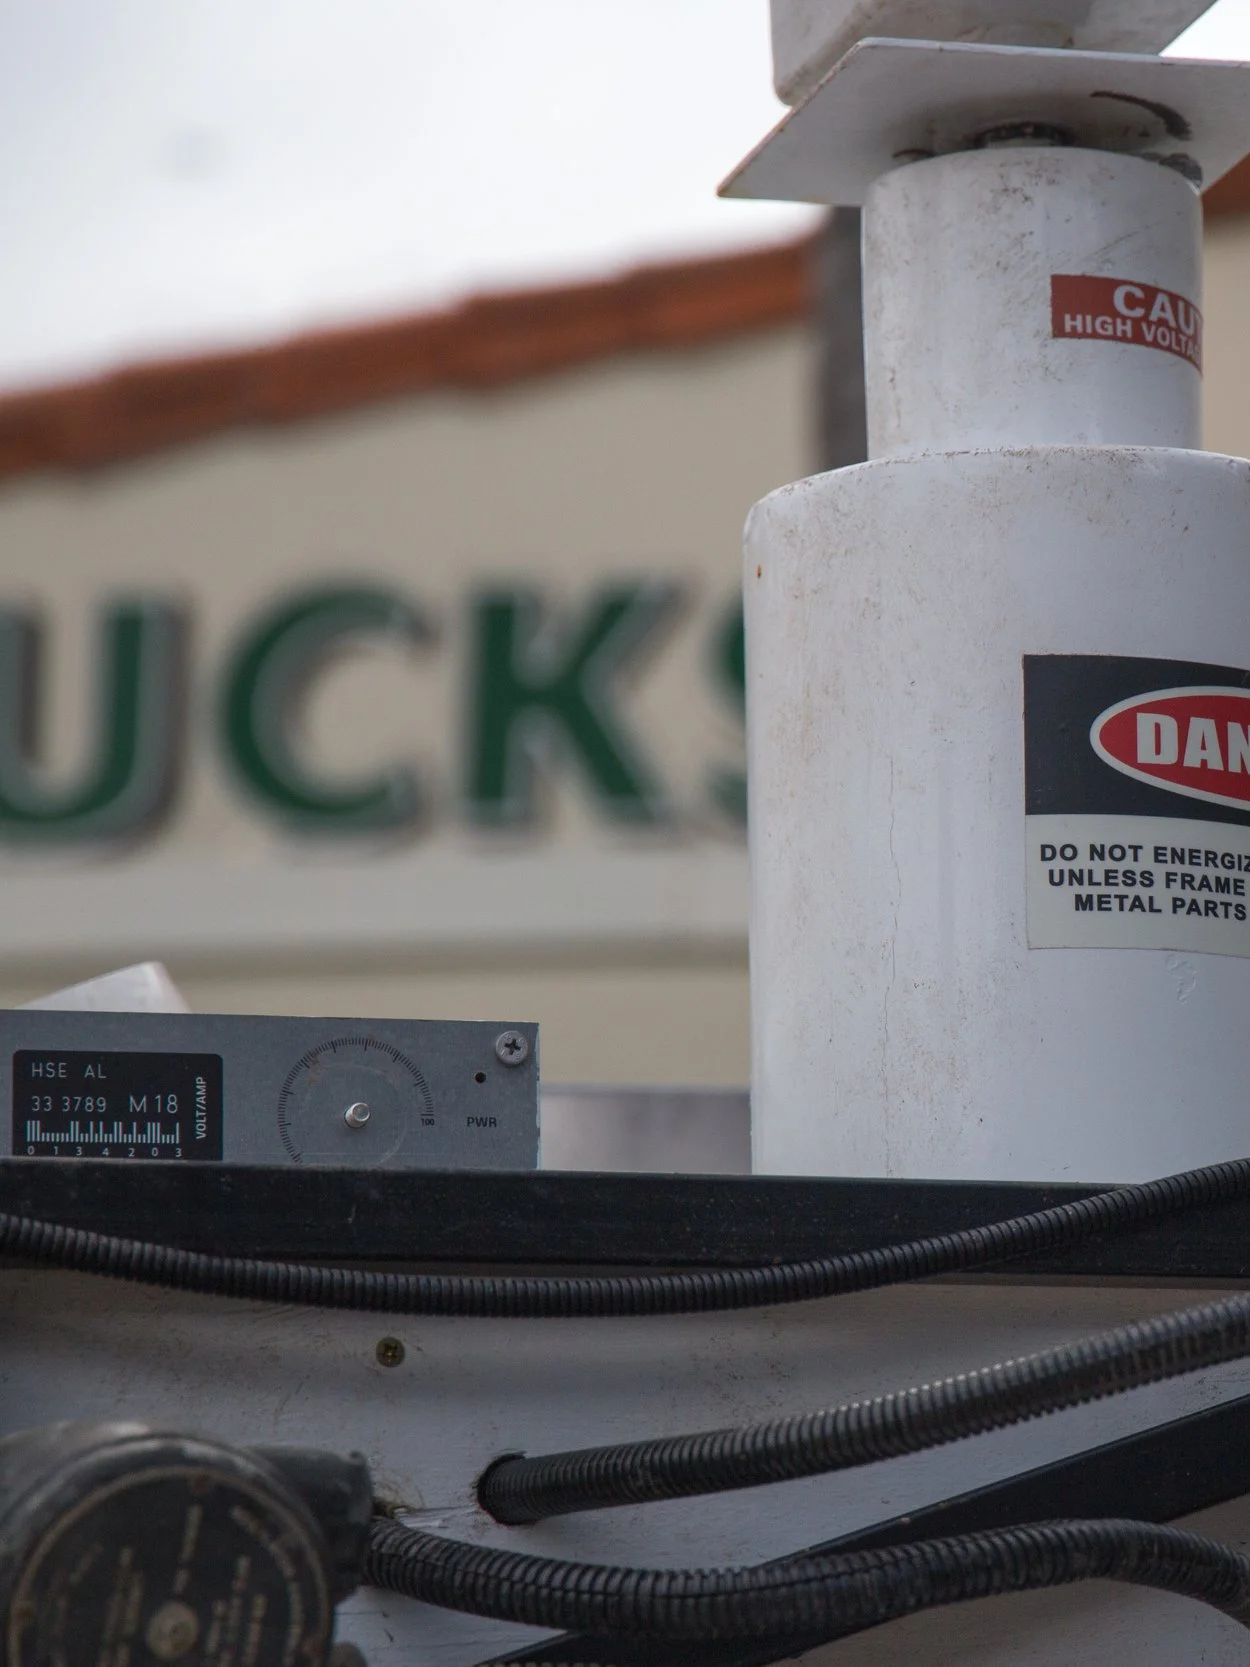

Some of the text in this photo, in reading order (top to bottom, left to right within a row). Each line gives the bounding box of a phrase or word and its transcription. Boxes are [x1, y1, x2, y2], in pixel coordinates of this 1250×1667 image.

[1064, 313, 1132, 338] HIGH
[0, 580, 745, 850] UCK
[1040, 844, 1078, 862] DO
[1089, 844, 1143, 863] NOT
[1049, 869, 1155, 888] UNLESS
[1165, 872, 1245, 897] FRAME
[1074, 894, 1162, 913] METAL
[1172, 898, 1247, 921] PARTS
[31, 1062, 107, 1079] HSE AL
[31, 1096, 53, 1112] 33
[62, 1097, 107, 1113] 3789
[196, 1076, 207, 1140] VOLT/AMP
[467, 1116, 497, 1128] PWR
